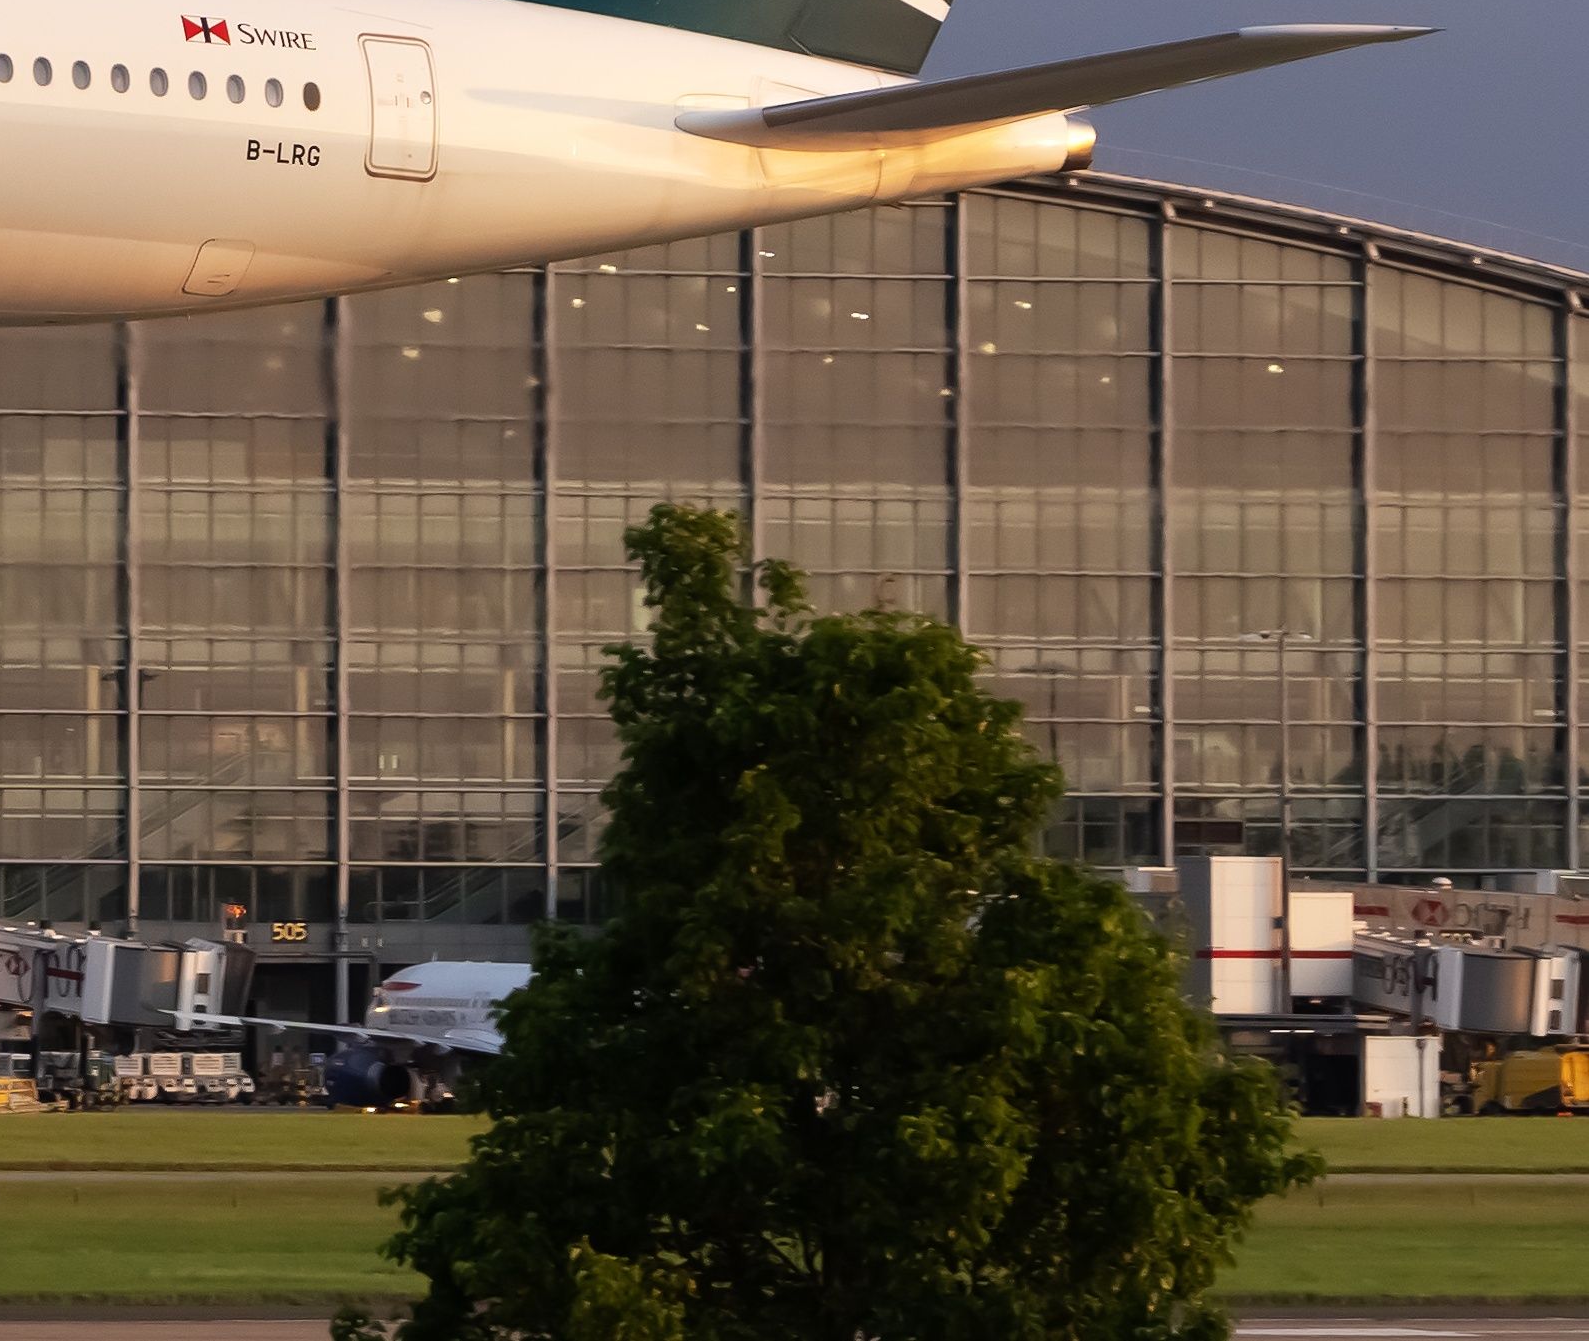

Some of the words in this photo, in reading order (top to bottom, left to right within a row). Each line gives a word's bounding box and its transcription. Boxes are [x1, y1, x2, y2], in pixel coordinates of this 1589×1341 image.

[237, 23, 317, 51] SWIRE
[246, 139, 321, 167] B-LRG
[271, 922, 308, 941] 505
